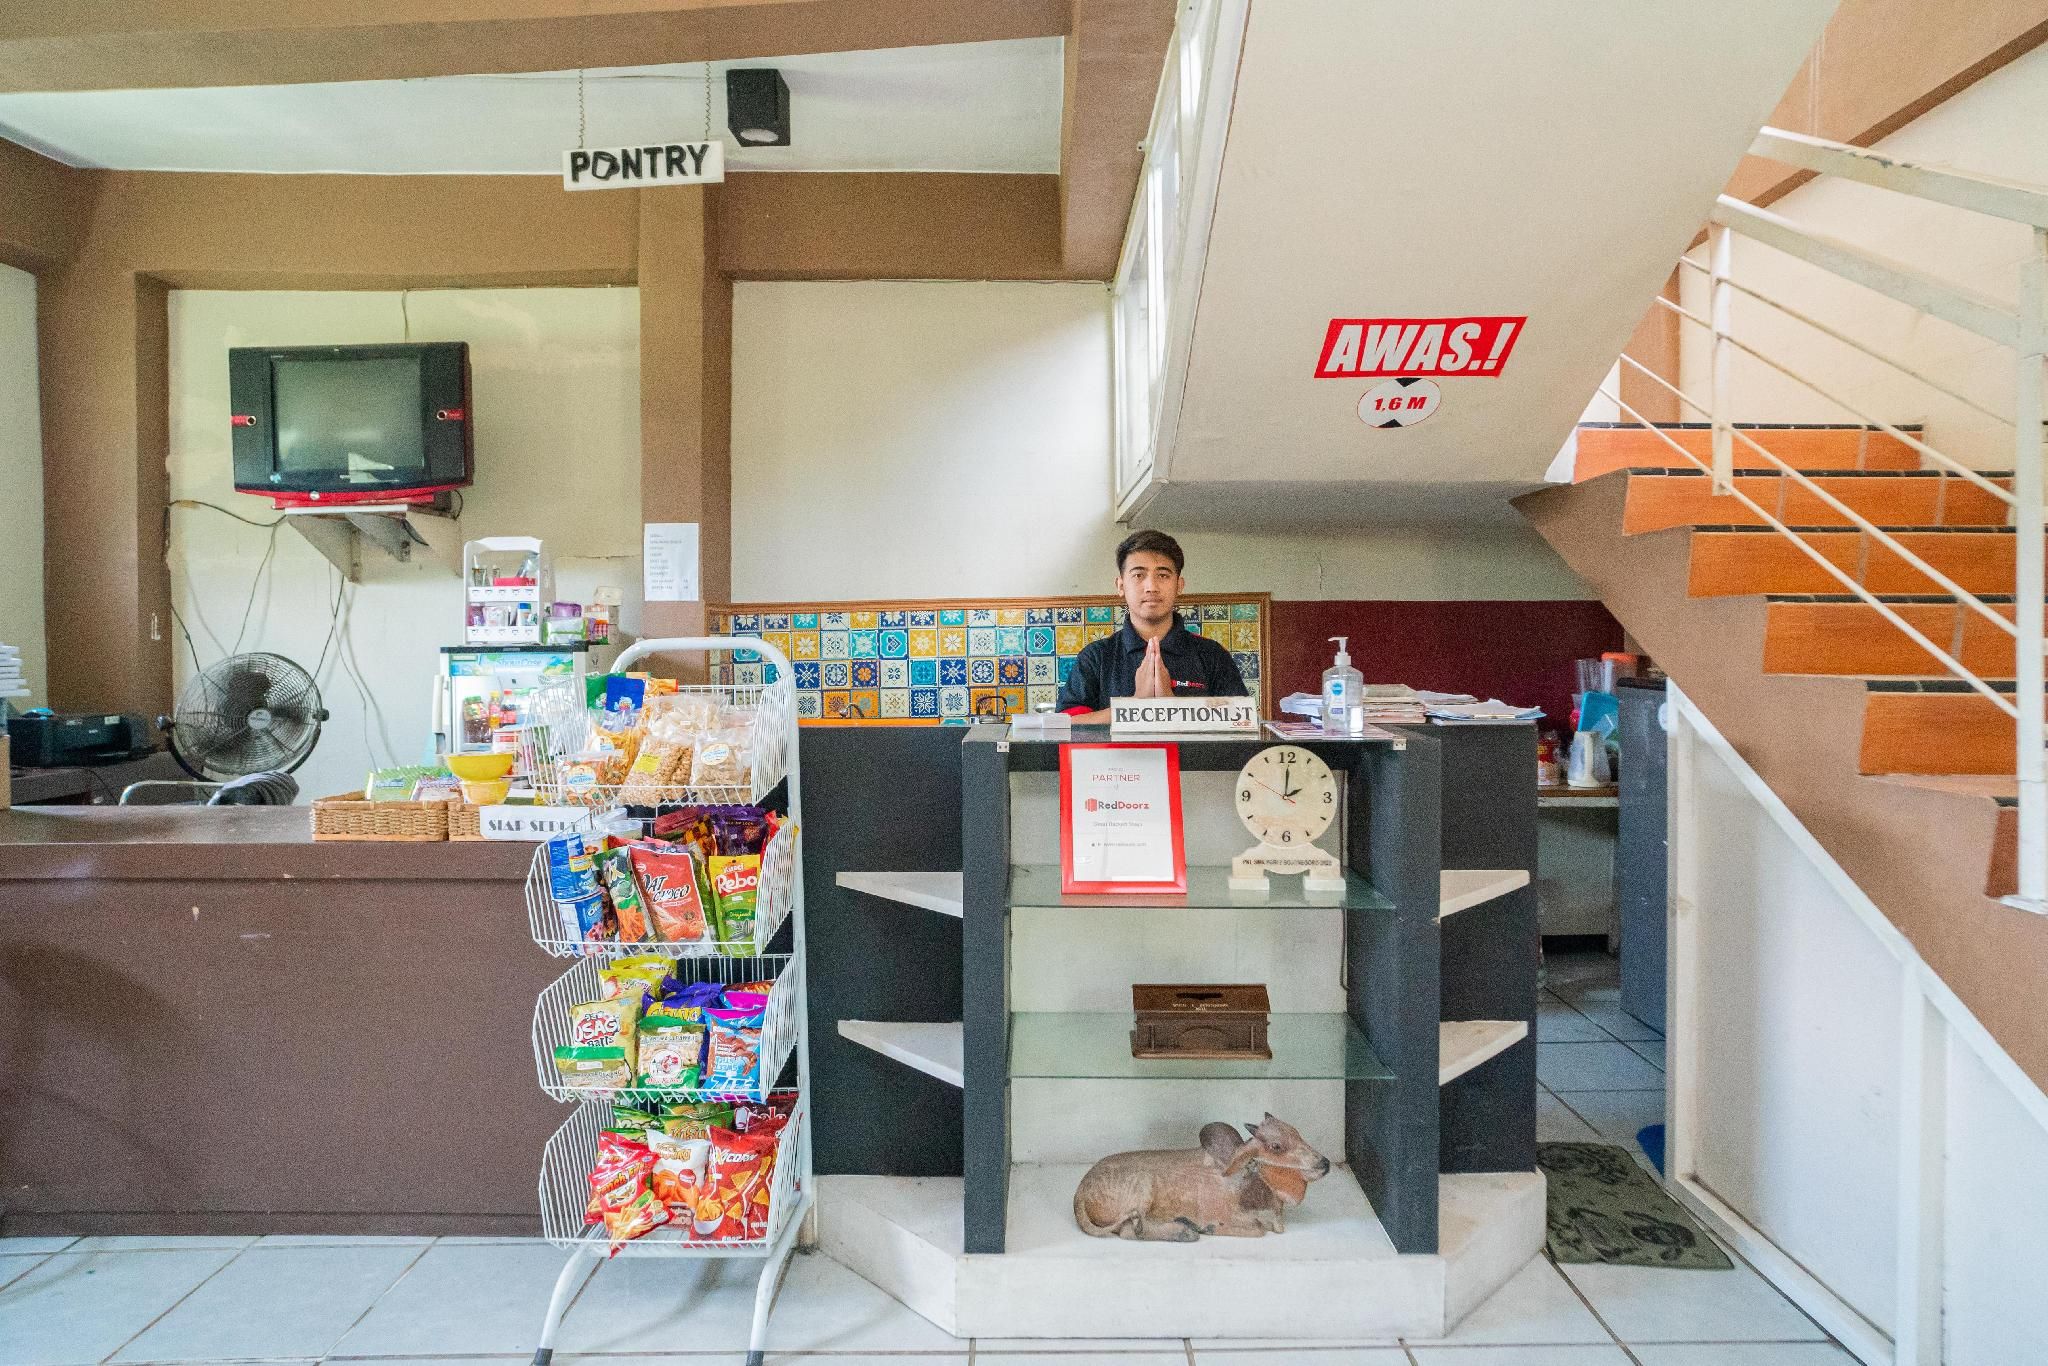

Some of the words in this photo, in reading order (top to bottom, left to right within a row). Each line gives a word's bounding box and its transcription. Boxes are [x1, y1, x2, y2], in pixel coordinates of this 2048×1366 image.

[1323, 322, 1517, 372] AWAS.!
[1407, 396, 1428, 410] M
[1115, 706, 1253, 723] RECEPTIONIST
[1279, 752, 1296, 764] 12
[1092, 774, 1141, 782] PARTNER
[1241, 790, 1251, 802] 9
[1323, 792, 1332, 804] 3
[1098, 800, 1149, 810] RedDoorz
[1282, 831, 1291, 842] 6
[715, 872, 758, 895] Rebo
